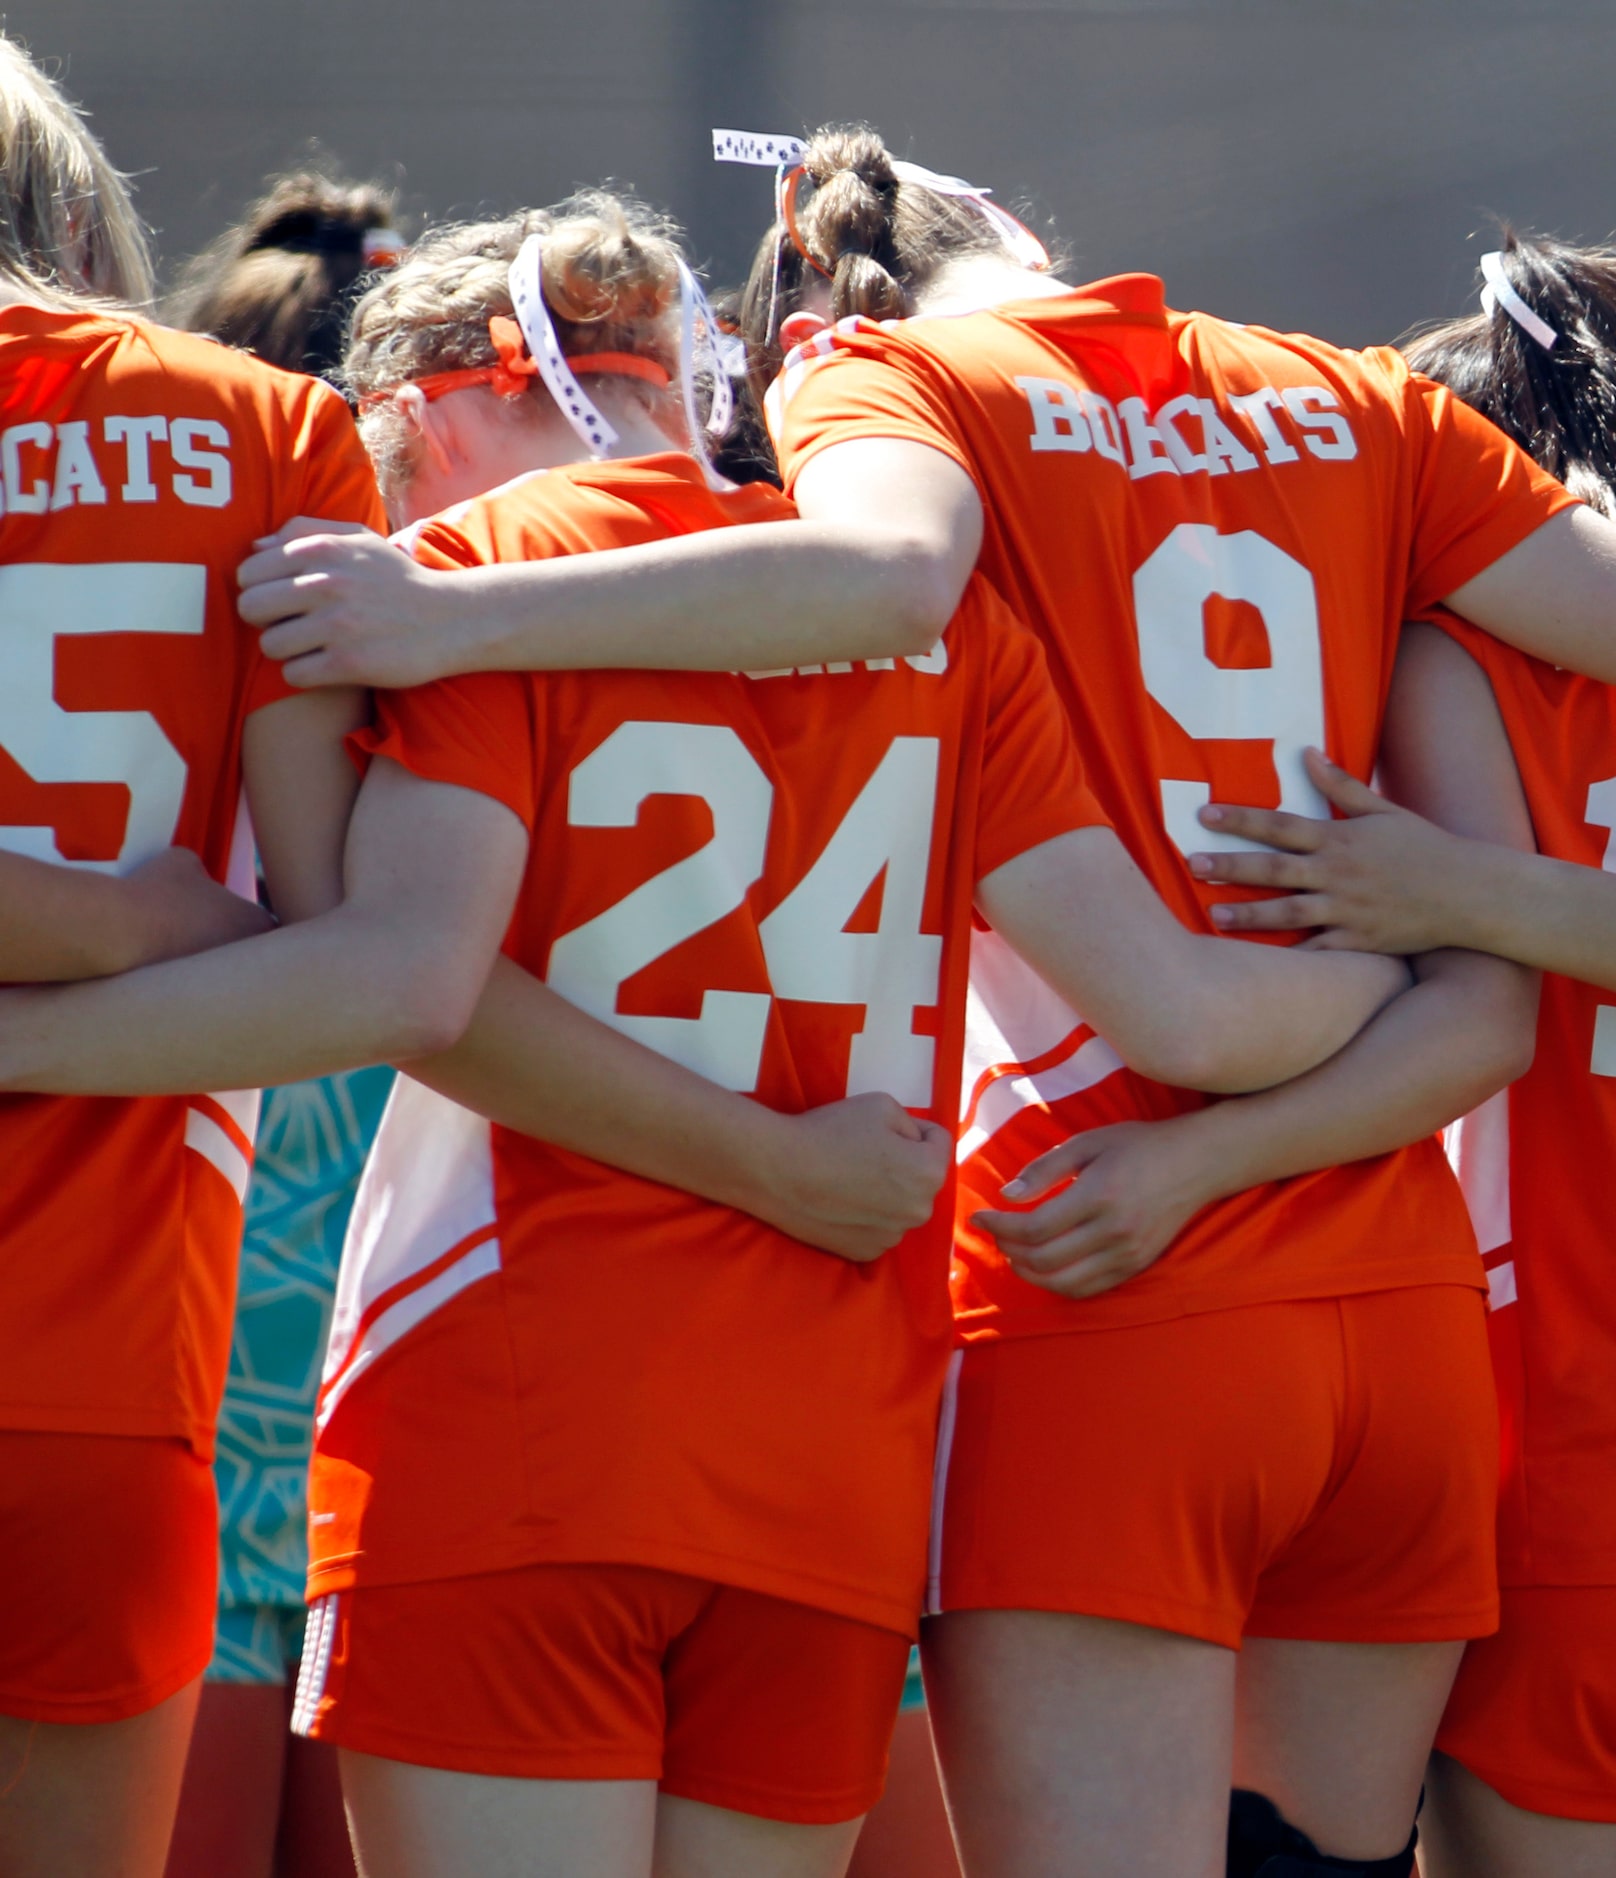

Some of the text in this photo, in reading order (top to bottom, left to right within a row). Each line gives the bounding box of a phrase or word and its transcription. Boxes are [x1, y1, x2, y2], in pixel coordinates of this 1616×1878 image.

[0, 415, 232, 517] CATS
[1132, 523, 1332, 884] 9
[545, 720, 944, 1109] 24
